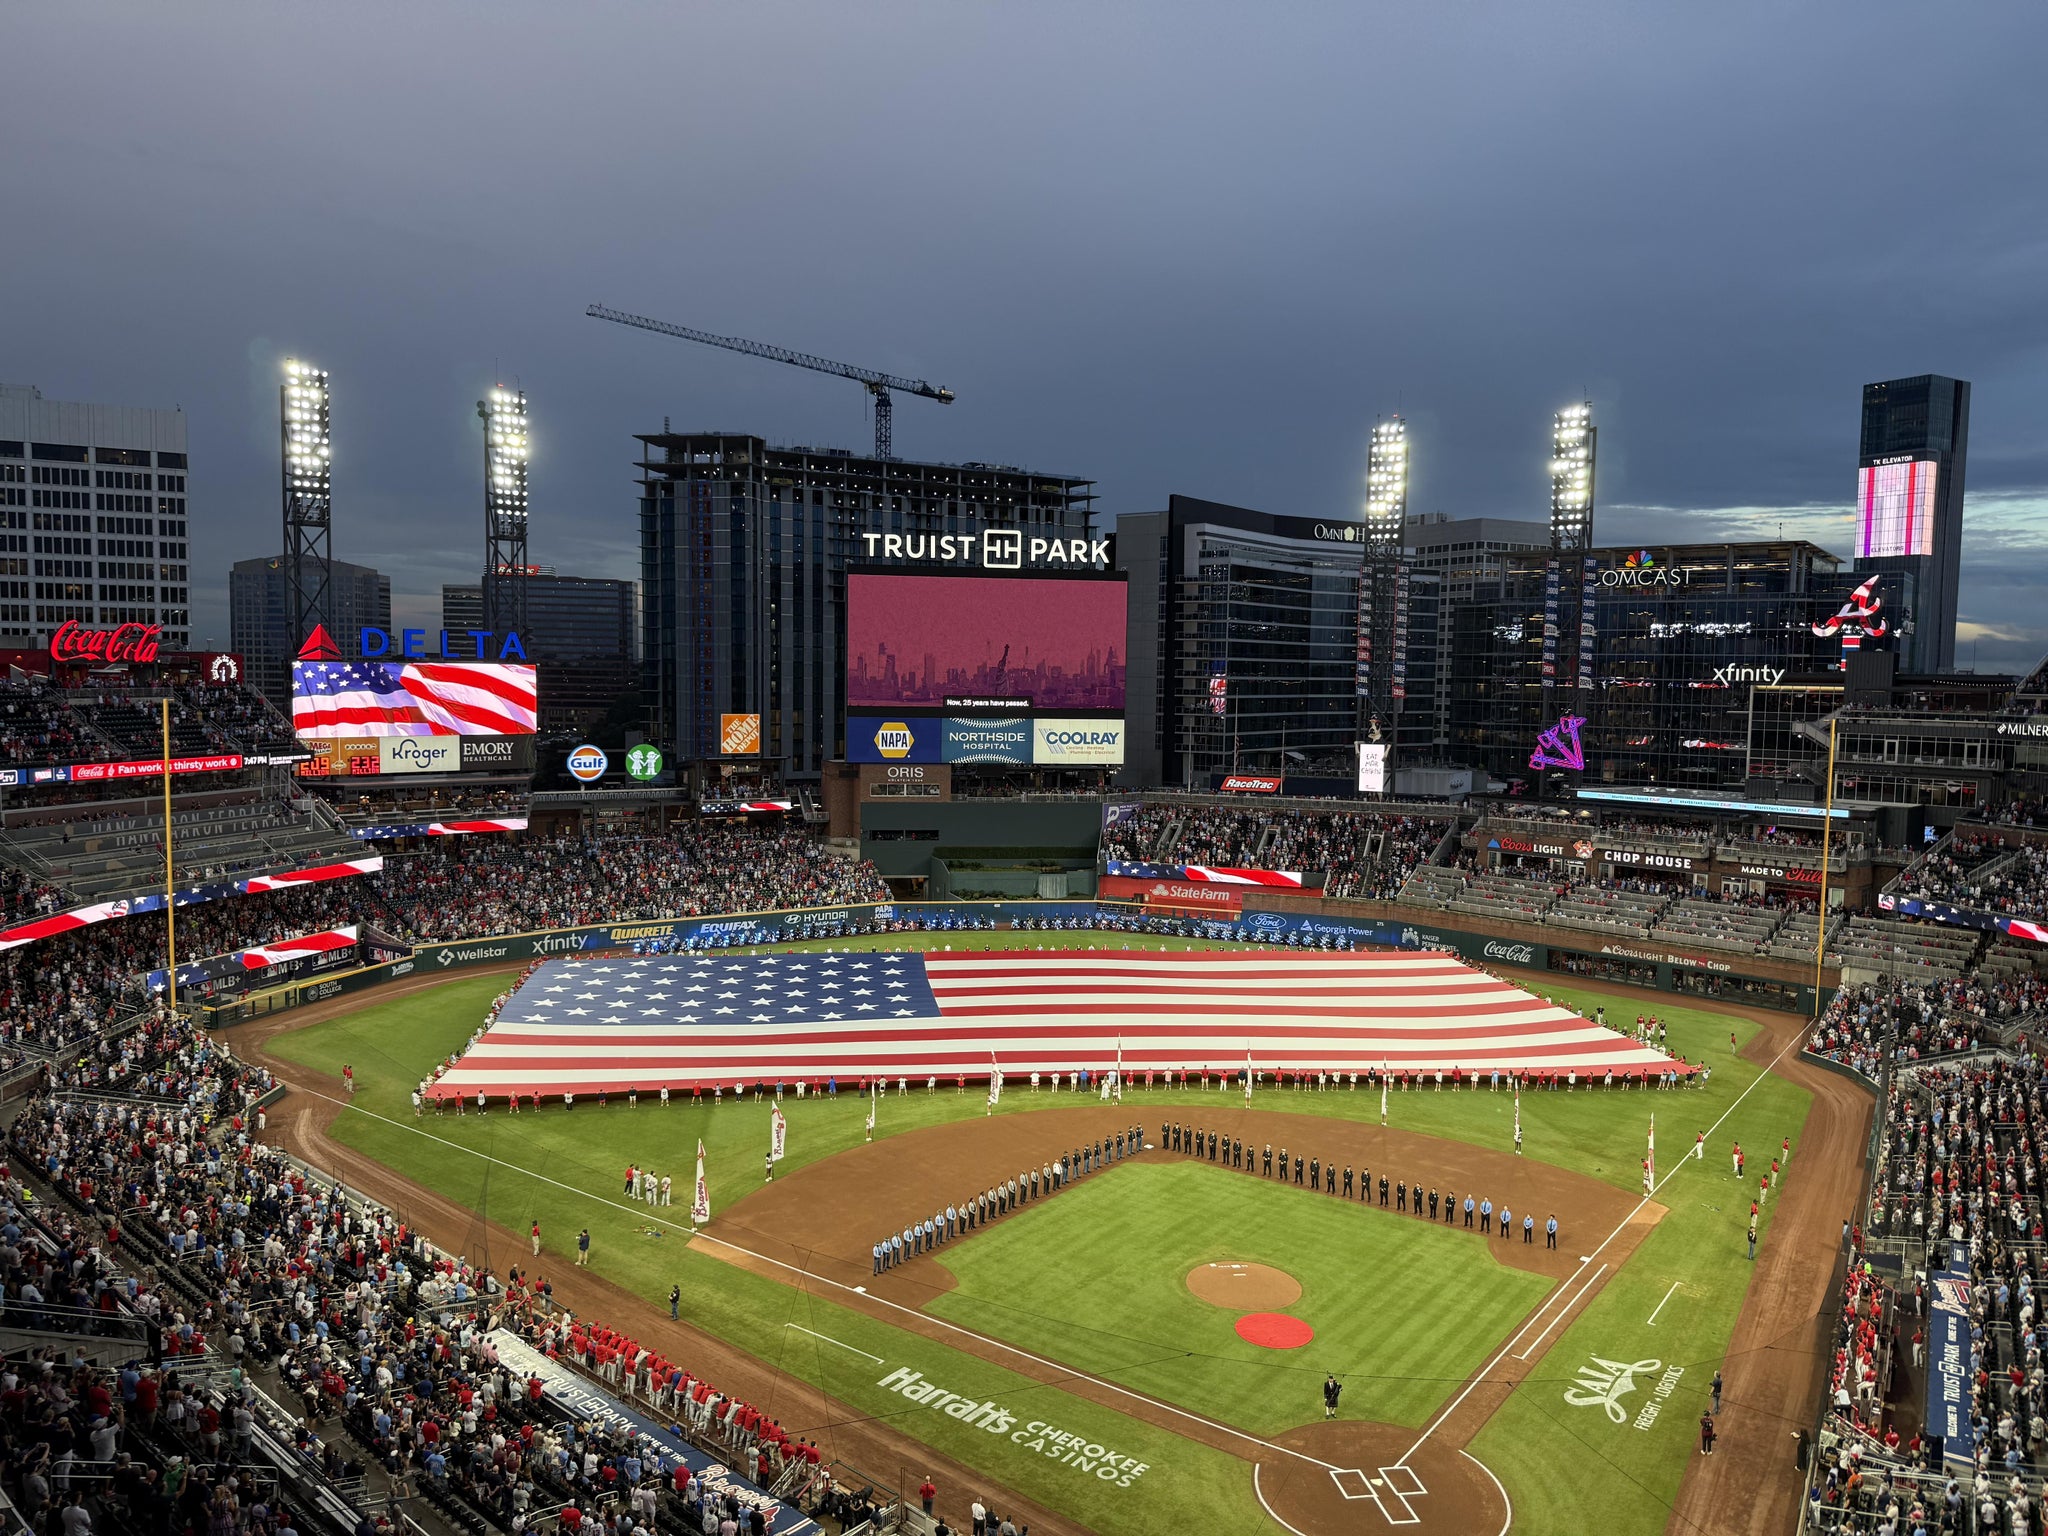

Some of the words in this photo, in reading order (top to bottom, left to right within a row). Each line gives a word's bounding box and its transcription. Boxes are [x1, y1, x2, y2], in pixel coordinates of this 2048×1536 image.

[862, 534, 976, 560] TRUIST
[1030, 539, 1110, 563] PARK
[51, 620, 162, 662] Coca-Cola
[360, 627, 527, 659] DELTA
[1712, 663, 1785, 686] xfinity
[722, 714, 759, 752] HOME
[726, 718, 740, 734] THE
[881, 732, 908, 748] NAPA
[950, 732, 1025, 742] NORTHSIDE
[1046, 732, 1119, 744] COOLRAY
[392, 739, 448, 768] Kroger
[464, 742, 514, 755] EMORY
[118, 764, 139, 774] Fan
[140, 763, 162, 773] work
[174, 760, 204, 770] thirsty
[206, 758, 228, 767] work
[352, 757, 380, 769] 232
[570, 758, 604, 769] Gulf
[888, 767, 924, 777] ORIS
[1225, 779, 1274, 789] RaceTrac
[1501, 838, 1532, 851] Coors
[1534, 844, 1564, 855] LIGHT
[1604, 851, 1640, 864] CHOP
[1645, 856, 1692, 869] HOUSE
[1741, 865, 1768, 876] MADE
[1771, 867, 1783, 877] TO
[804, 911, 848, 922] HYUNDAI
[1255, 915, 1280, 928] Ford
[611, 925, 674, 940] QUIKRETE
[700, 920, 757, 934] EQUIFAX
[1314, 924, 1346, 934] Georgia
[1348, 926, 1374, 936] Power
[532, 934, 589, 955] xfinity
[1484, 940, 1534, 962] Coca-Cola
[329, 948, 352, 962] MLB+
[456, 946, 507, 962] Wellstar
[1612, 945, 1638, 957] Coors
[1639, 952, 1663, 961] LIGHT
[1668, 954, 1697, 966] BELOW
[1707, 961, 1730, 972] CHOP
[212, 976, 241, 991] MLB+
[319, 981, 338, 989] SOUTH
[319, 985, 342, 995] COLLEGE
[696, 1182, 708, 1217] Braves
[1944, 1343, 1959, 1364] PARK
[1944, 1373, 1960, 1403] TRUIST
[547, 1374, 590, 1402] TRUIST
[599, 1408, 638, 1431] PARK
[876, 1366, 1017, 1434] Harrah's
[1632, 1400, 1662, 1432] FREIGHT
[1653, 1365, 1685, 1398] LOGISTICS
[1947, 1413, 1957, 1438] WELCOME
[638, 1432, 662, 1448] HOME
[660, 1446, 674, 1454] OF
[1026, 1421, 1150, 1477] CHEROKEE
[1010, 1431, 1136, 1488] CASINOS
[697, 1464, 780, 1511] Braves
